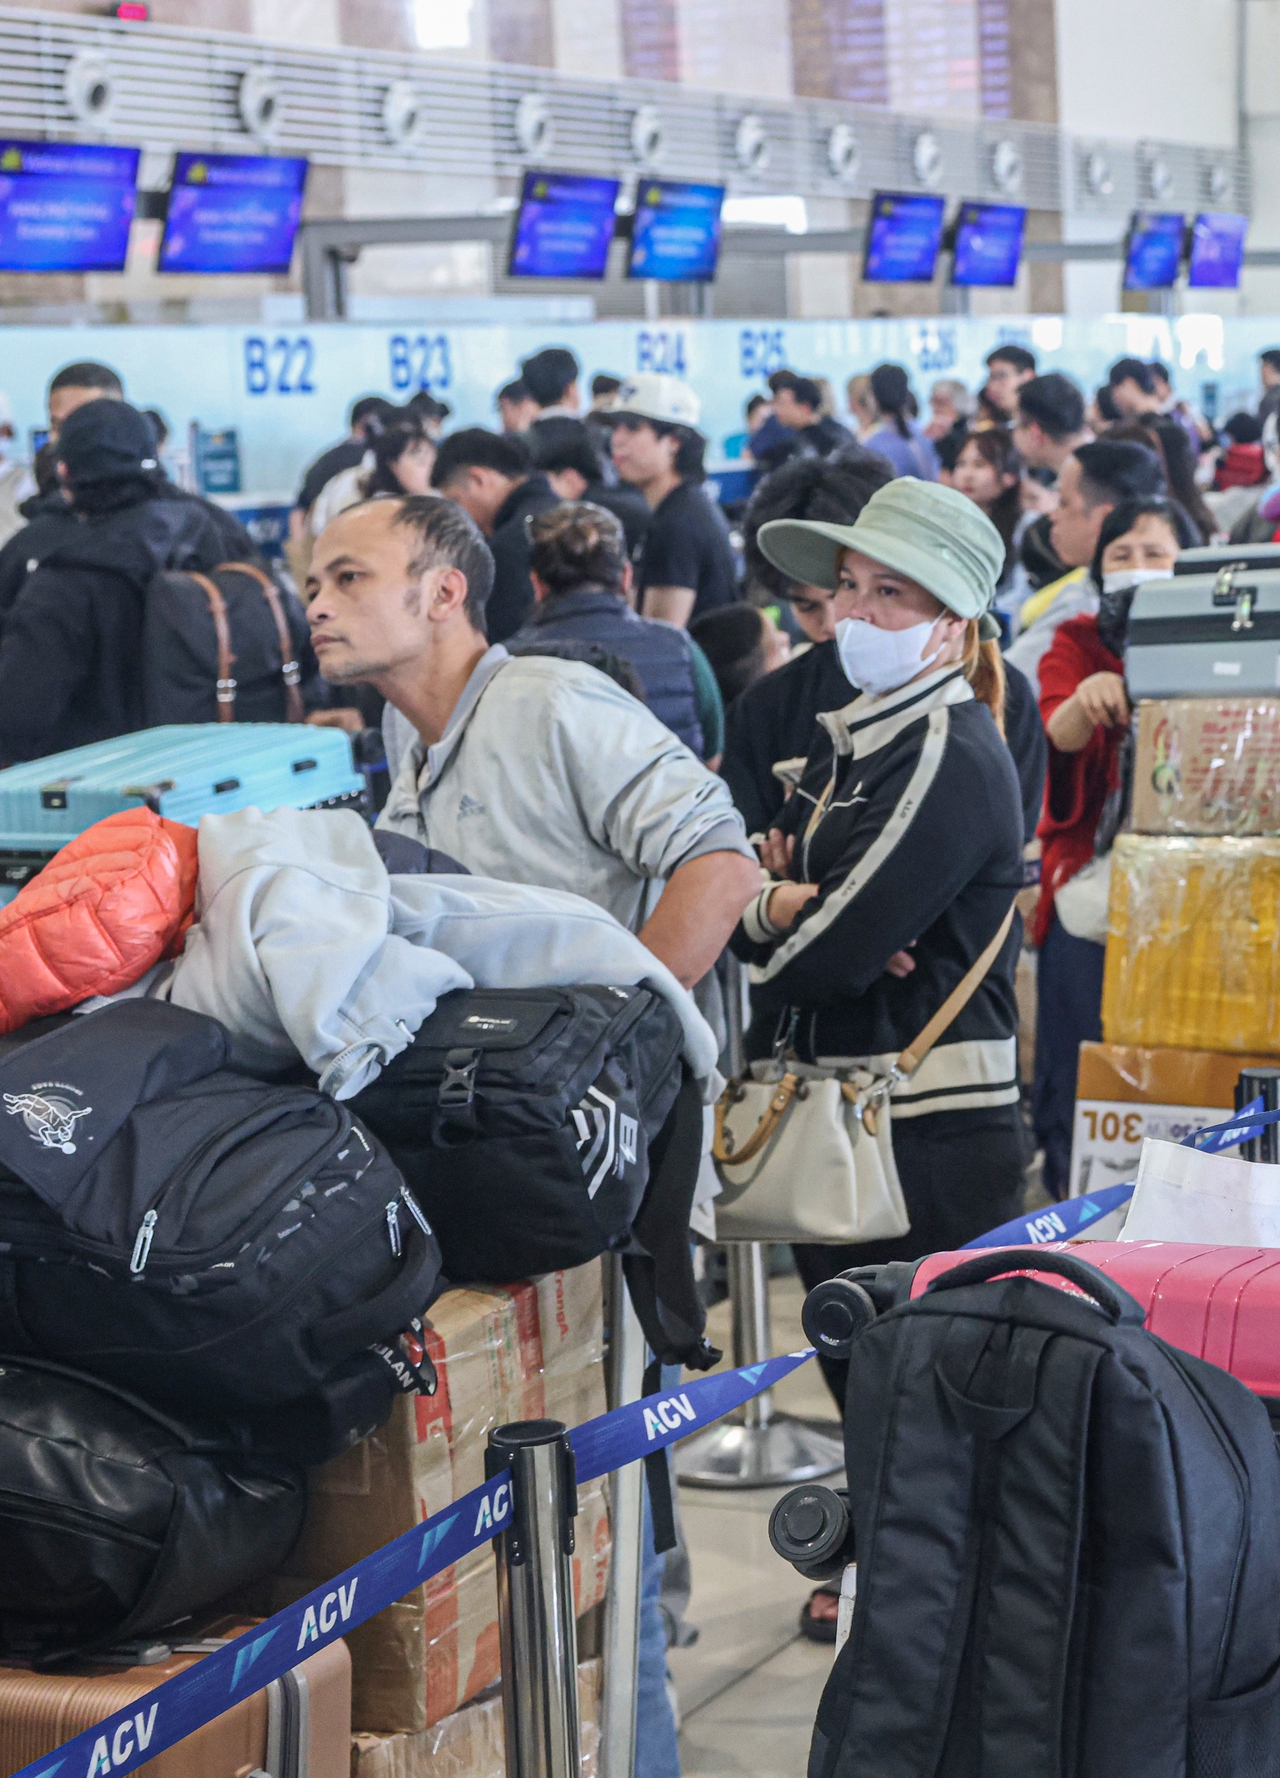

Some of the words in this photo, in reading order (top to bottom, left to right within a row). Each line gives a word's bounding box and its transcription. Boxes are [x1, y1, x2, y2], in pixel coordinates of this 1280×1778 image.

[245, 337, 315, 394] B22
[389, 336, 449, 390] B23
[1082, 1110, 1143, 1144] 30L
[1024, 1211, 1068, 1244] ACV
[642, 1392, 697, 1441] ACV
[296, 1576, 358, 1652] ACV
[85, 1701, 159, 1778] ACV
